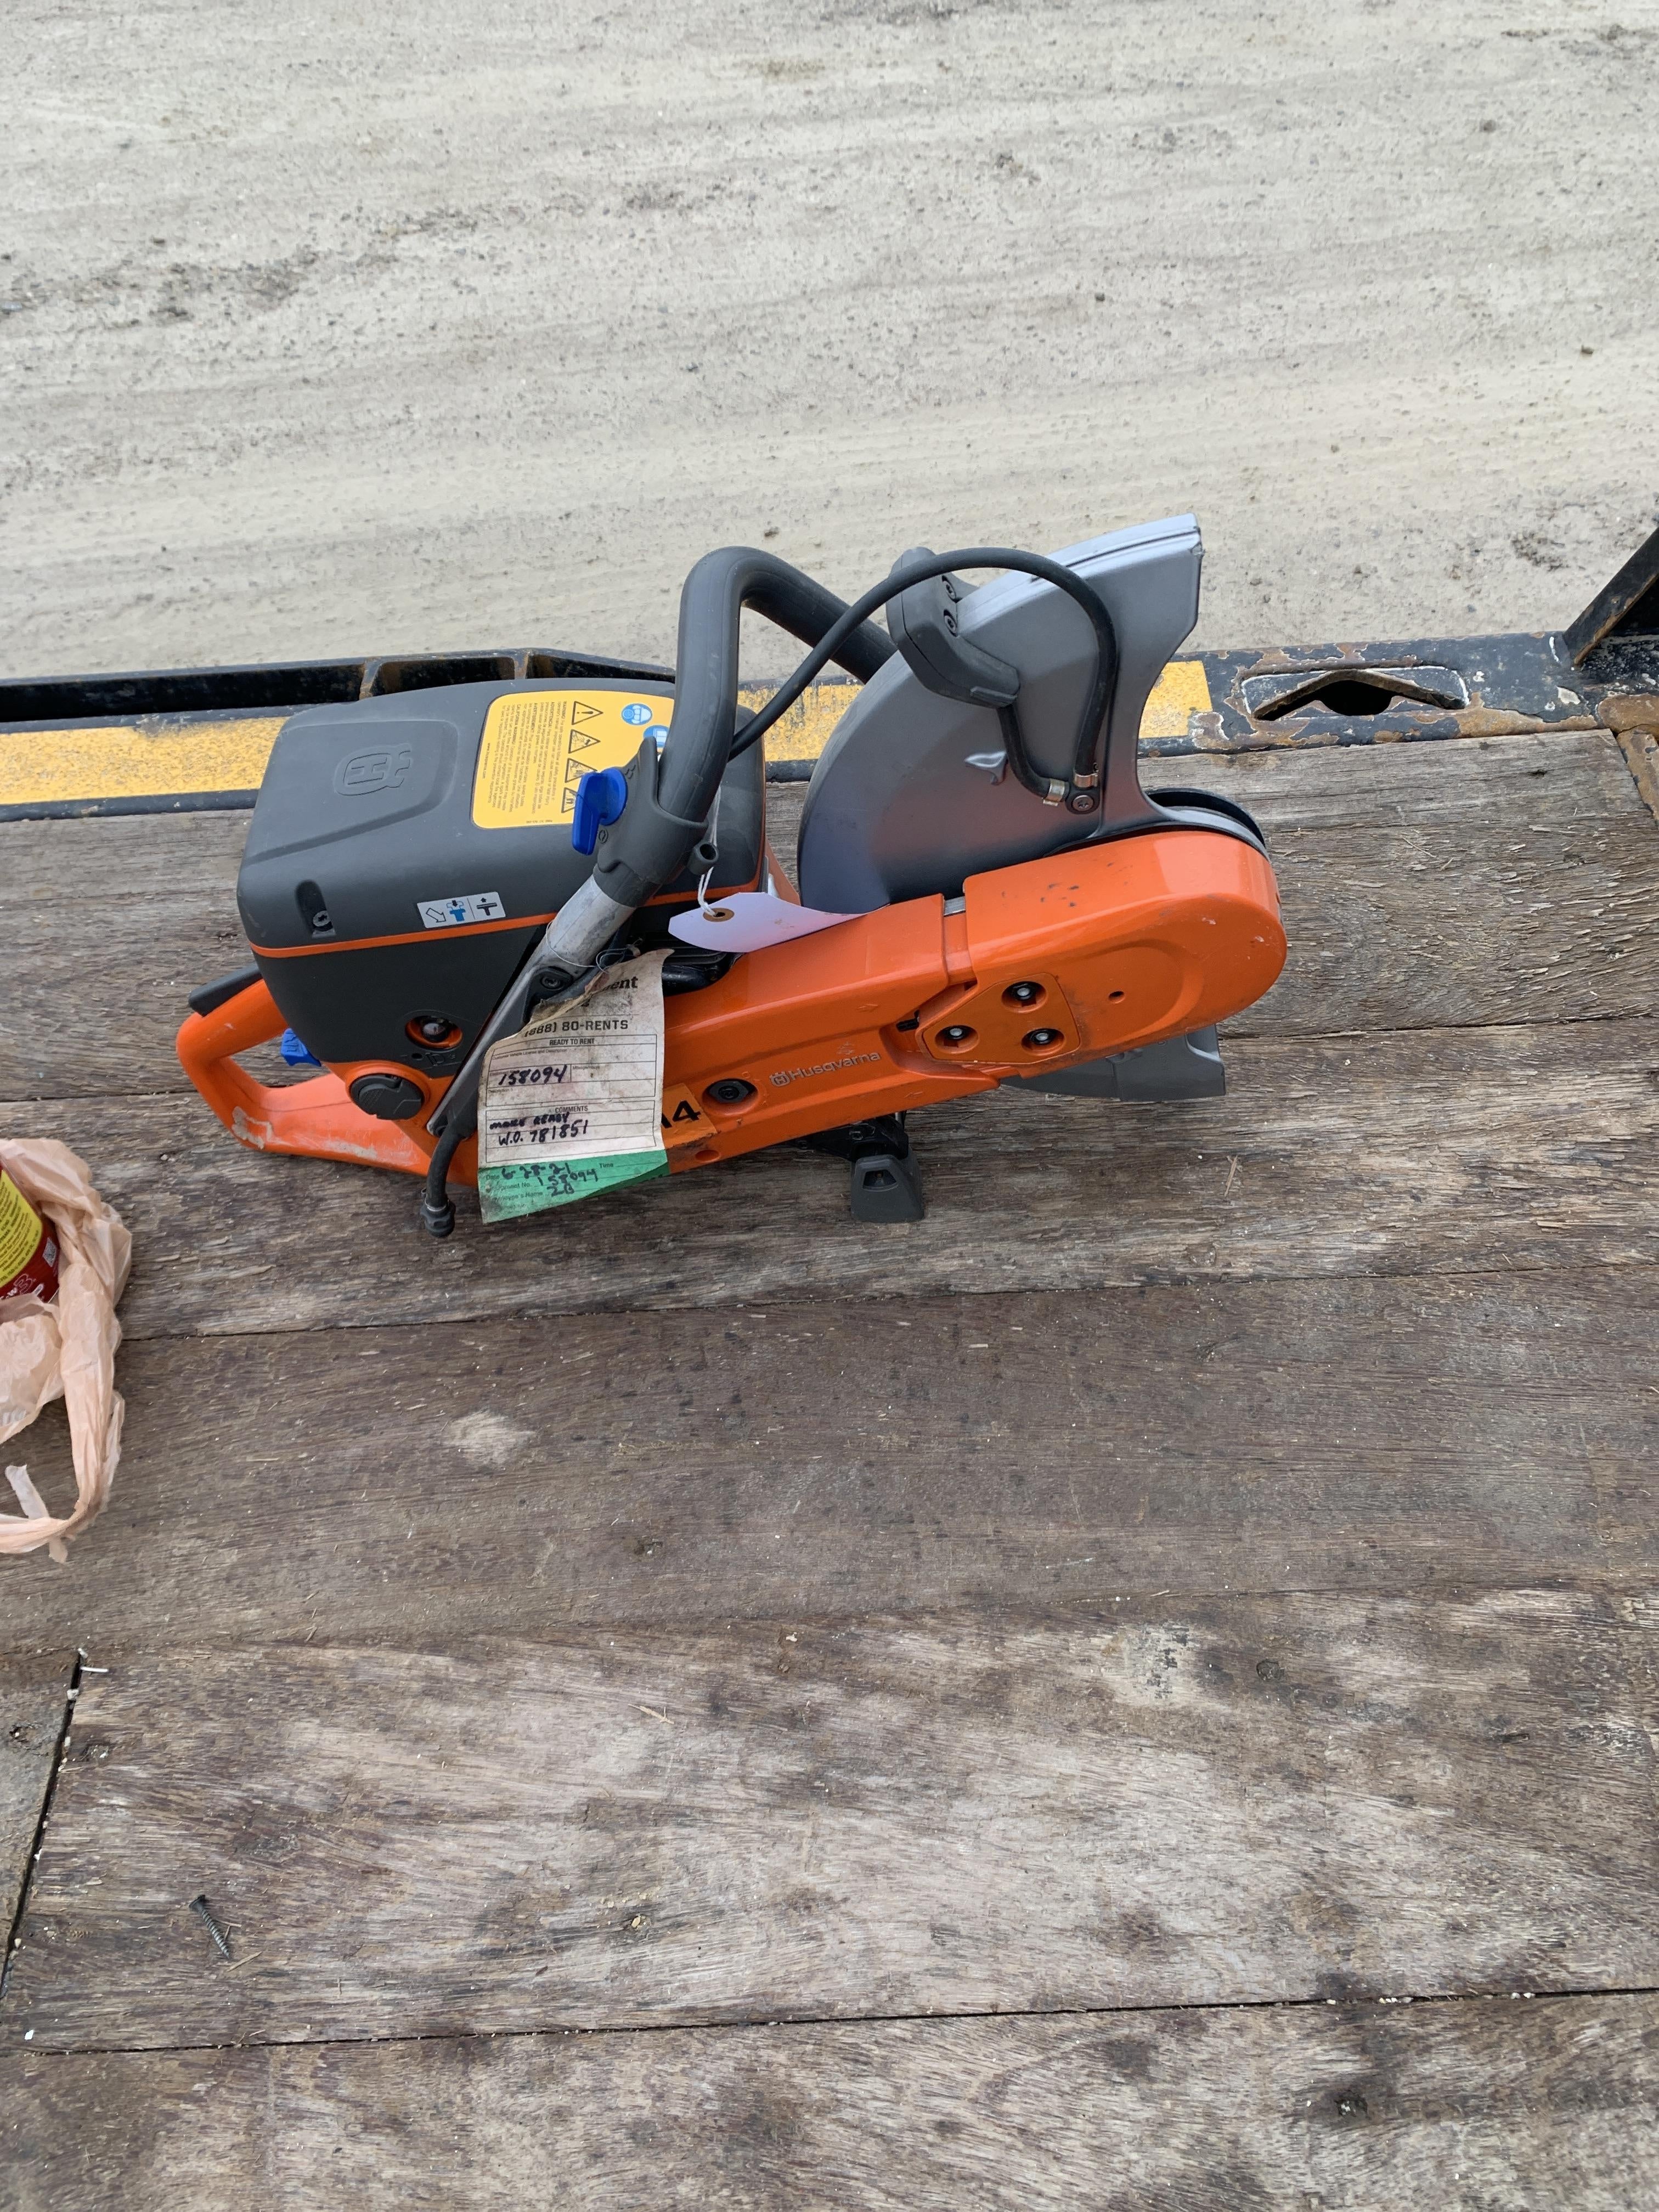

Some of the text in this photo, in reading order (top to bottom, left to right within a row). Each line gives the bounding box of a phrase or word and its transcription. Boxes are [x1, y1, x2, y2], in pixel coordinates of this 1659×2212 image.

[605, 976, 639, 991] ent
[562, 1019, 629, 1031] 80-RENTS
[549, 1038, 569, 1046] READY
[499, 1064, 567, 1086] 158094
[789, 1052, 881, 1081] Husqvarna
[499, 1119, 589, 1146] W.O. 781851
